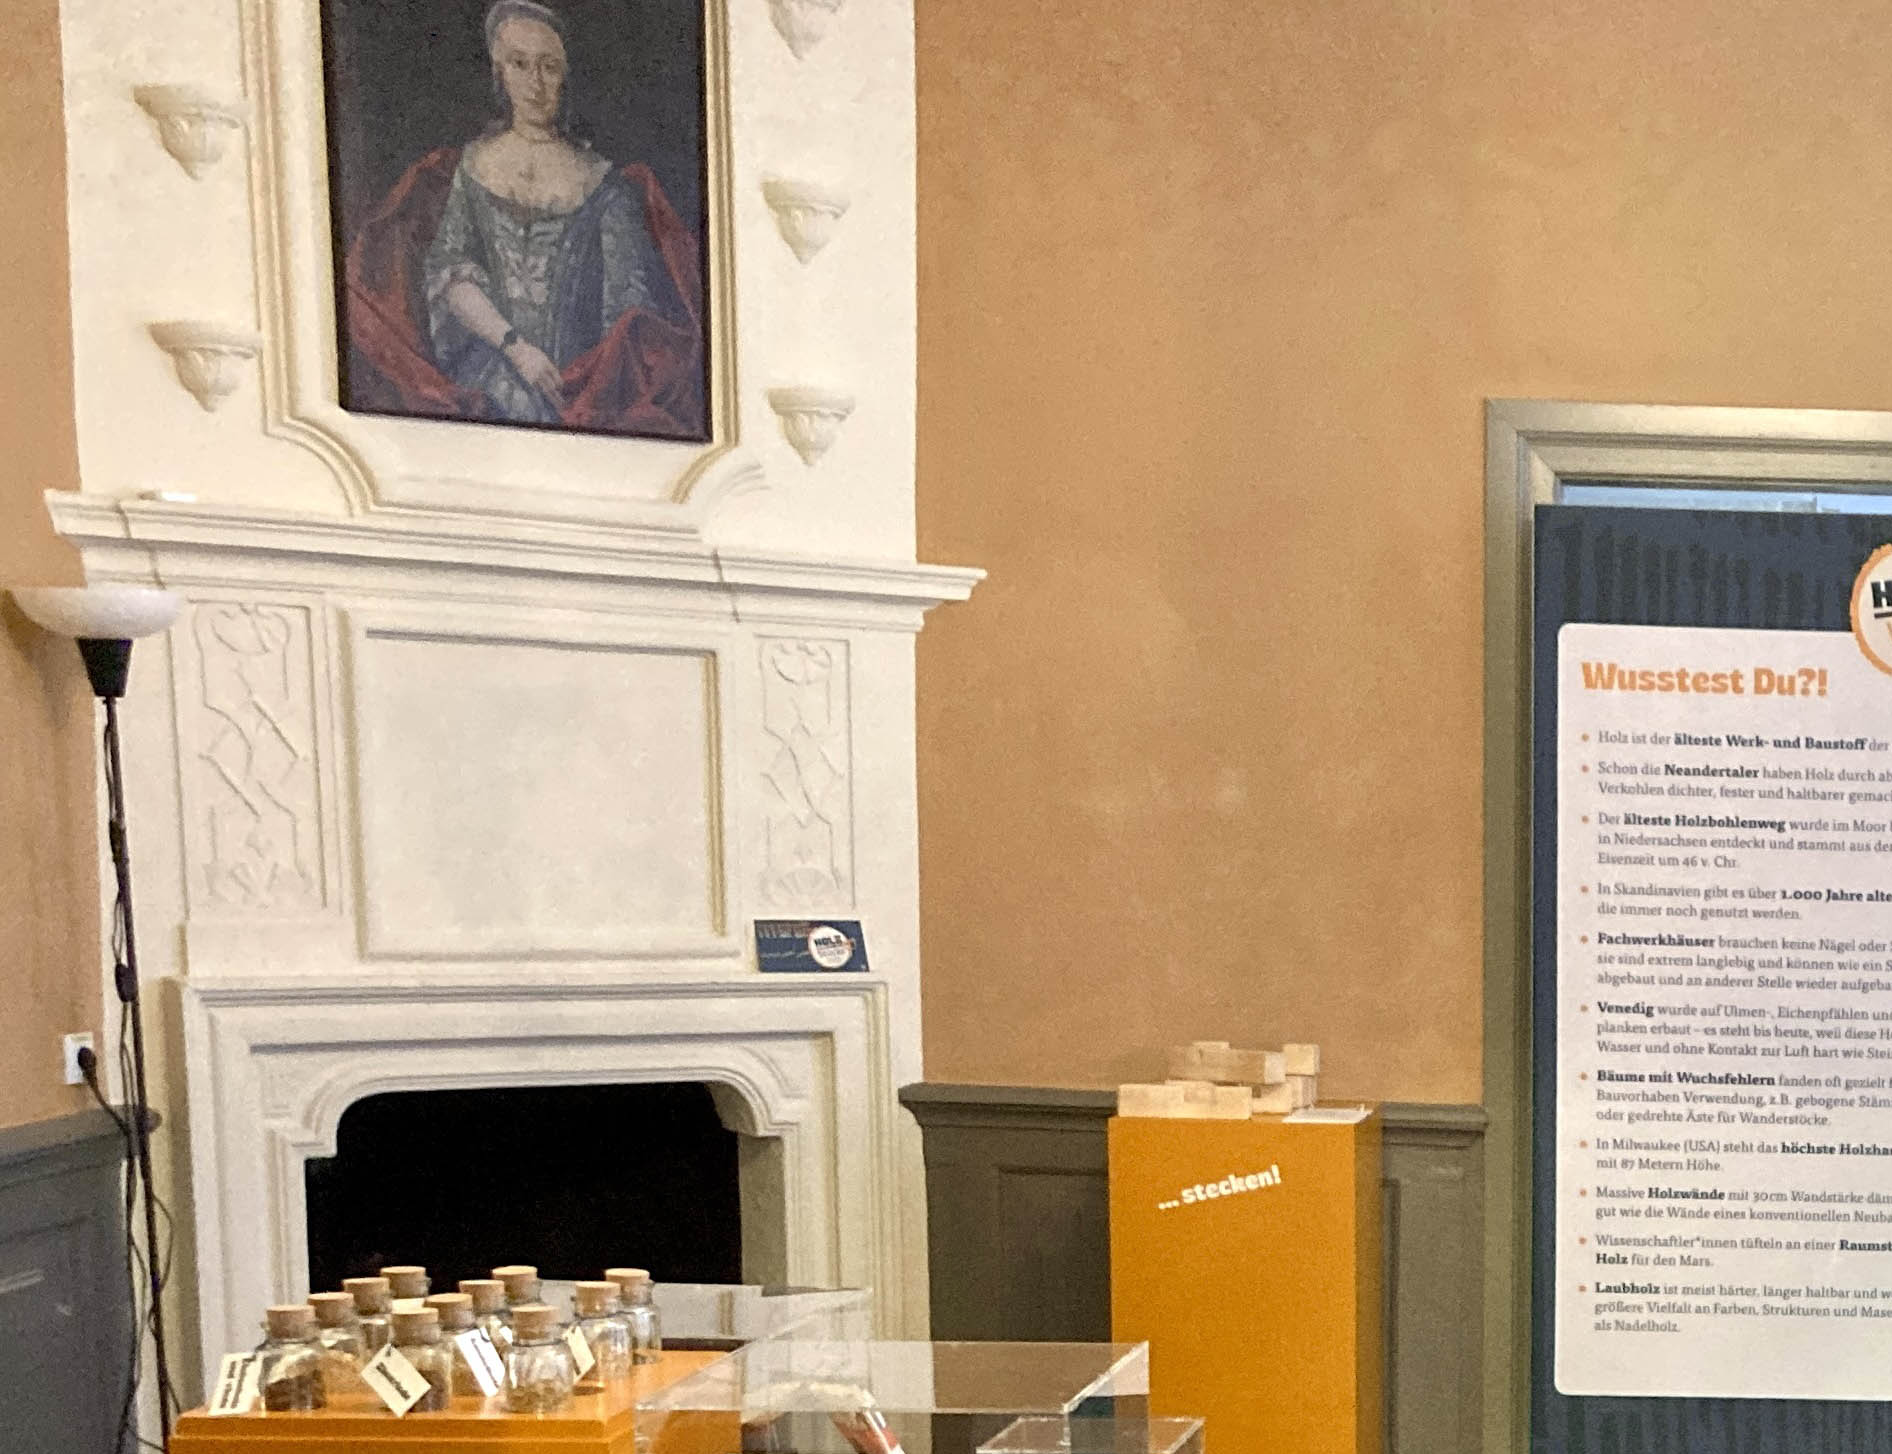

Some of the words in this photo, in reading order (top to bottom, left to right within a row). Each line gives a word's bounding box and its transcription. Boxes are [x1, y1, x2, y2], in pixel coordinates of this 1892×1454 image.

[1581, 662, 1744, 694] Wusstest
[1754, 668, 1828, 697] Du?!
[1598, 730, 1628, 744] Holz
[1630, 731, 1647, 744] ist
[1649, 731, 1671, 745] der
[1673, 732, 1722, 746] älteste
[1725, 733, 1768, 748] Werk-
[1772, 735, 1800, 748] und
[1804, 735, 1866, 750] Baustoff
[1597, 761, 1637, 775] Schon
[1640, 762, 1661, 775] die
[1663, 762, 1758, 778] Neandertaler
[1761, 765, 1802, 780] haben
[1804, 767, 1835, 781] Holz
[1836, 768, 1875, 782] durch
[1597, 781, 1664, 796] Verkohlen
[1718, 784, 1755, 798] fester
[1757, 786, 1783, 799] und
[1785, 786, 1844, 801] haltbarer
[1597, 811, 1620, 825] Der
[1623, 812, 1671, 826] älteste
[1674, 813, 1786, 832] Holzbohlenweg
[1788, 817, 1829, 831] wurde
[1852, 819, 1886, 833] Moor
[1613, 832, 1707, 847] Niedersachsen
[1709, 835, 1766, 849] entdeckt
[1768, 836, 1794, 850] und
[1796, 837, 1847, 851] stammt
[1682, 854, 1697, 867] 46
[1613, 882, 1701, 897] Skandinavien
[1703, 885, 1728, 900] gibt
[1746, 886, 1777, 899] über
[1779, 890, 1822, 900] 1.000
[1825, 888, 1863, 901] Jahre
[1866, 889, 1892, 902] alte
[1619, 902, 1662, 916] immer
[1665, 903, 1697, 917] noch
[1699, 904, 1749, 921] genutzt
[1597, 931, 1715, 947] Fachwerkhäuser
[1717, 935, 1778, 949] brauchen
[1780, 937, 1816, 950] keine
[1817, 938, 1855, 954] Nägel
[1857, 939, 1886, 952] oder
[1617, 952, 1644, 965] sind
[1646, 953, 1693, 966] extrem
[1694, 954, 1755, 971] langlebig
[1785, 956, 1833, 970] können
[1596, 971, 1655, 987] abgebaut
[1705, 974, 1754, 987] anderer
[1756, 975, 1792, 988] Stelle
[1795, 976, 1837, 989] wieder
[1597, 1001, 1654, 1017] Venedig
[1655, 1002, 1697, 1016] wurde
[1777, 1006, 1868, 1023] Eichenpfählen
[1596, 1021, 1647, 1037] planken
[1649, 1022, 1691, 1035] erbaut
[1719, 1024, 1750, 1037] steht
[1843, 1027, 1877, 1040] diese
[1596, 1040, 1641, 1053] Wasser
[1643, 1041, 1670, 1054] und
[1672, 1041, 1704, 1054] ohne
[1707, 1042, 1757, 1056] Kontakt
[1783, 1044, 1809, 1057] Luft
[1812, 1045, 1838, 1058] hart
[1597, 1069, 1645, 1082] Bäume
[1648, 1070, 1673, 1083] mit
[1676, 1071, 1775, 1086] Wuchsfehlern
[1776, 1074, 1822, 1087] fanden
[1843, 1076, 1885, 1091] gezielt
[1596, 1089, 1680, 1103] Bauvorhaben
[1794, 1094, 1854, 1109] gebogene
[1595, 1108, 1624, 1120] oder
[1627, 1109, 1682, 1124] gedrehte
[1684, 1110, 1715, 1123] Äste
[1716, 1111, 1736, 1123] für
[1611, 1138, 1680, 1151] Milwaukee
[1683, 1139, 1720, 1154] (USA)
[1723, 1140, 1754, 1153] steht
[1756, 1141, 1778, 1153] das
[1780, 1141, 1835, 1154] höchste
[1620, 1157, 1636, 1171] 87
[1637, 1157, 1683, 1170] Metern
[1595, 1185, 1645, 1198] Massive
[1647, 1187, 1725, 1200] Holzwände
[1751, 1193, 1787, 1204] 30cm
[1789, 1190, 1864, 1203] Wandstärke
[1595, 1205, 1616, 1219] gut
[1644, 1206, 1663, 1218] die
[1665, 1206, 1710, 1219] Wände
[1712, 1207, 1746, 1220] eines
[1748, 1208, 1850, 1222] konventionellen
[1739, 1237, 1782, 1249] tüfteln
[1802, 1238, 1835, 1250] einer
[1595, 1252, 1627, 1265] Holz
[1630, 1253, 1650, 1265] für
[1652, 1254, 1676, 1266] den
[1595, 1281, 1660, 1294] Laubholz
[1680, 1283, 1715, 1295] meist
[1761, 1285, 1802, 1300] länger
[1804, 1286, 1850, 1298] haltbar
[1851, 1287, 1877, 1299] und
[1594, 1300, 1644, 1315] größere
[1646, 1302, 1691, 1314] Vielfalt
[1761, 1304, 1830, 1317] Strukturen
[1831, 1305, 1857, 1317] und
